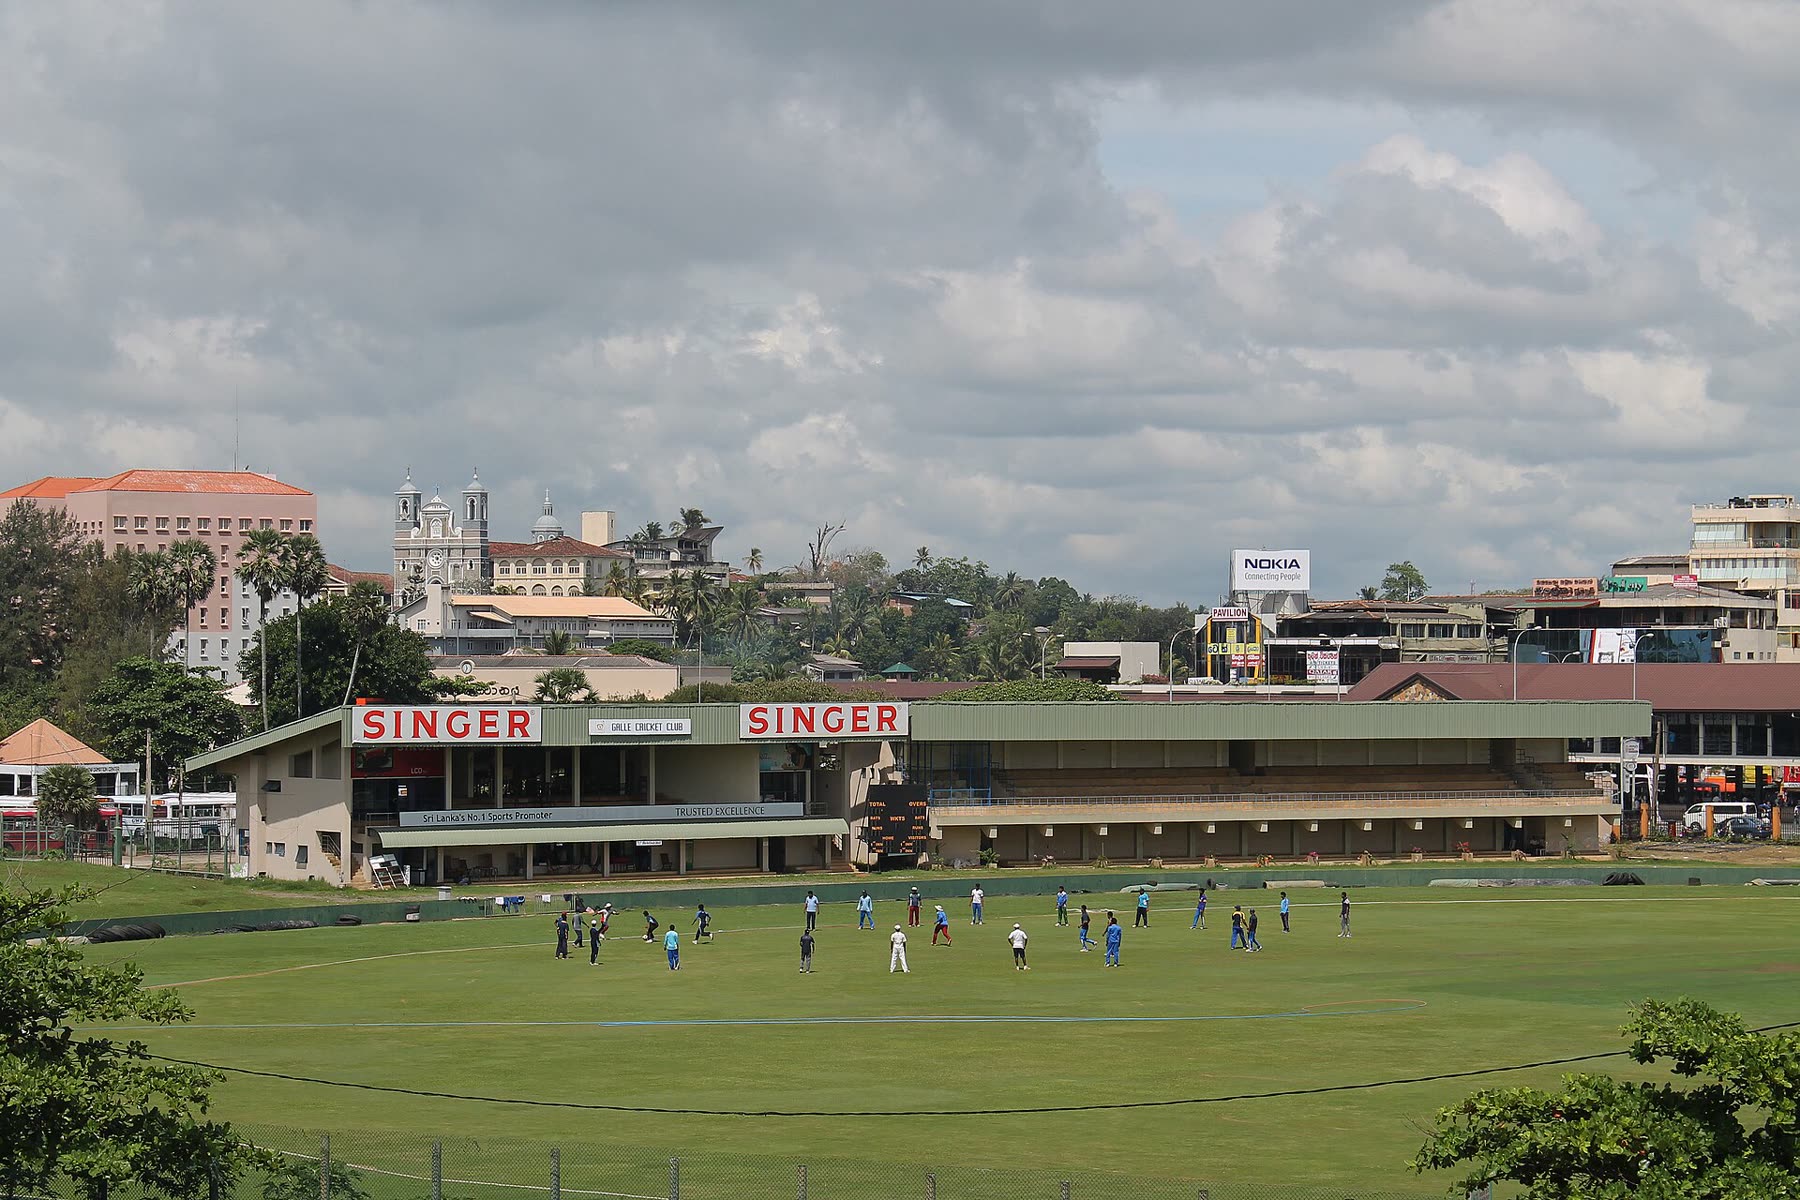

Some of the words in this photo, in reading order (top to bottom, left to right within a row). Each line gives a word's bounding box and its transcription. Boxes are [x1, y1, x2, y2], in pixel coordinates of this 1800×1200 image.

[1244, 559, 1301, 569] NOKIA
[1244, 572, 1279, 581] Connecting
[1280, 572, 1301, 581] People
[1213, 608, 1247, 617] PAVILION
[363, 710, 530, 739] SINGER
[749, 705, 897, 734] SINGER
[611, 723, 631, 731] GALLE
[635, 723, 662, 731] CRICKET
[666, 722, 683, 731] CLUB
[675, 807, 713, 817] TRUSTED
[715, 806, 765, 816] EXCELLENCE
[423, 814, 434, 823] Sri
[436, 813, 466, 822] Lanka's
[488, 812, 513, 822] Sports
[515, 811, 553, 820] Promoter
